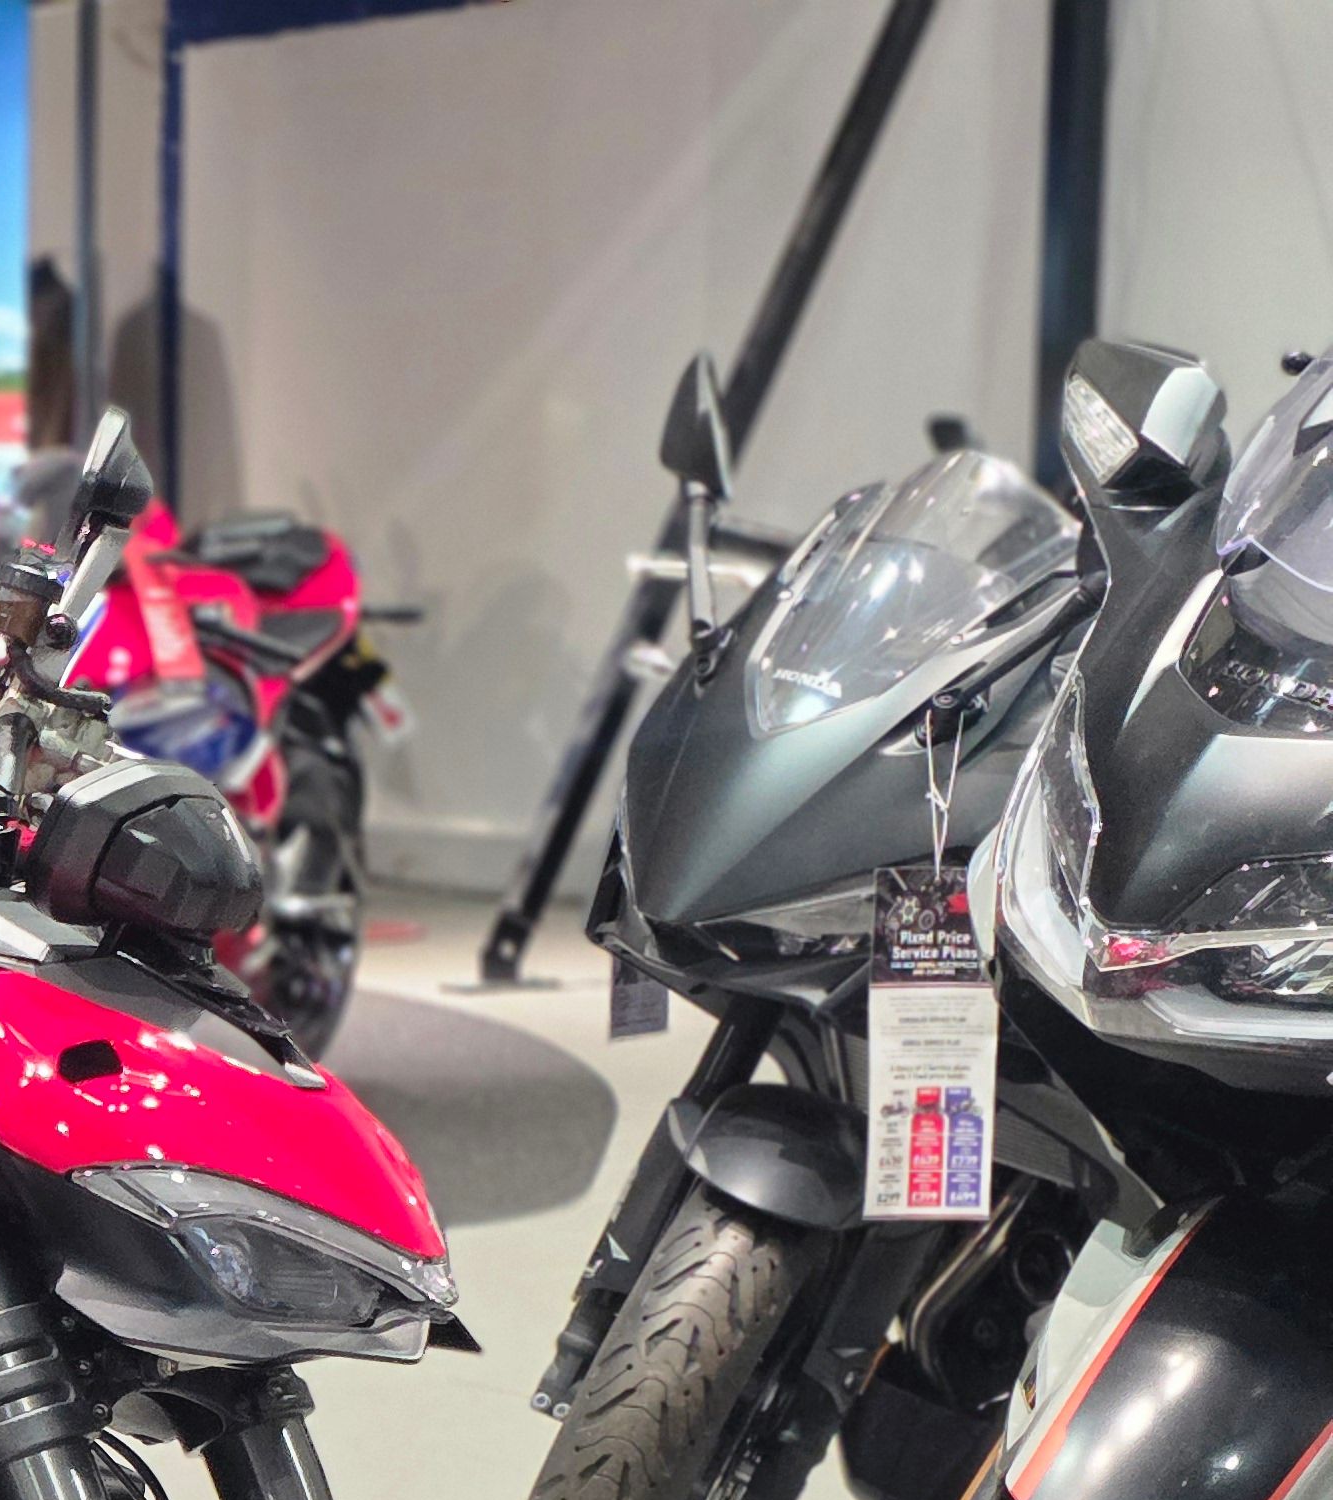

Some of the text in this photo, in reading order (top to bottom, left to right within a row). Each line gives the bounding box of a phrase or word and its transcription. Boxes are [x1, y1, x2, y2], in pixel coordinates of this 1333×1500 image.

[900, 929, 972, 945] Fixed Price
[892, 945, 978, 960] Service Plans
